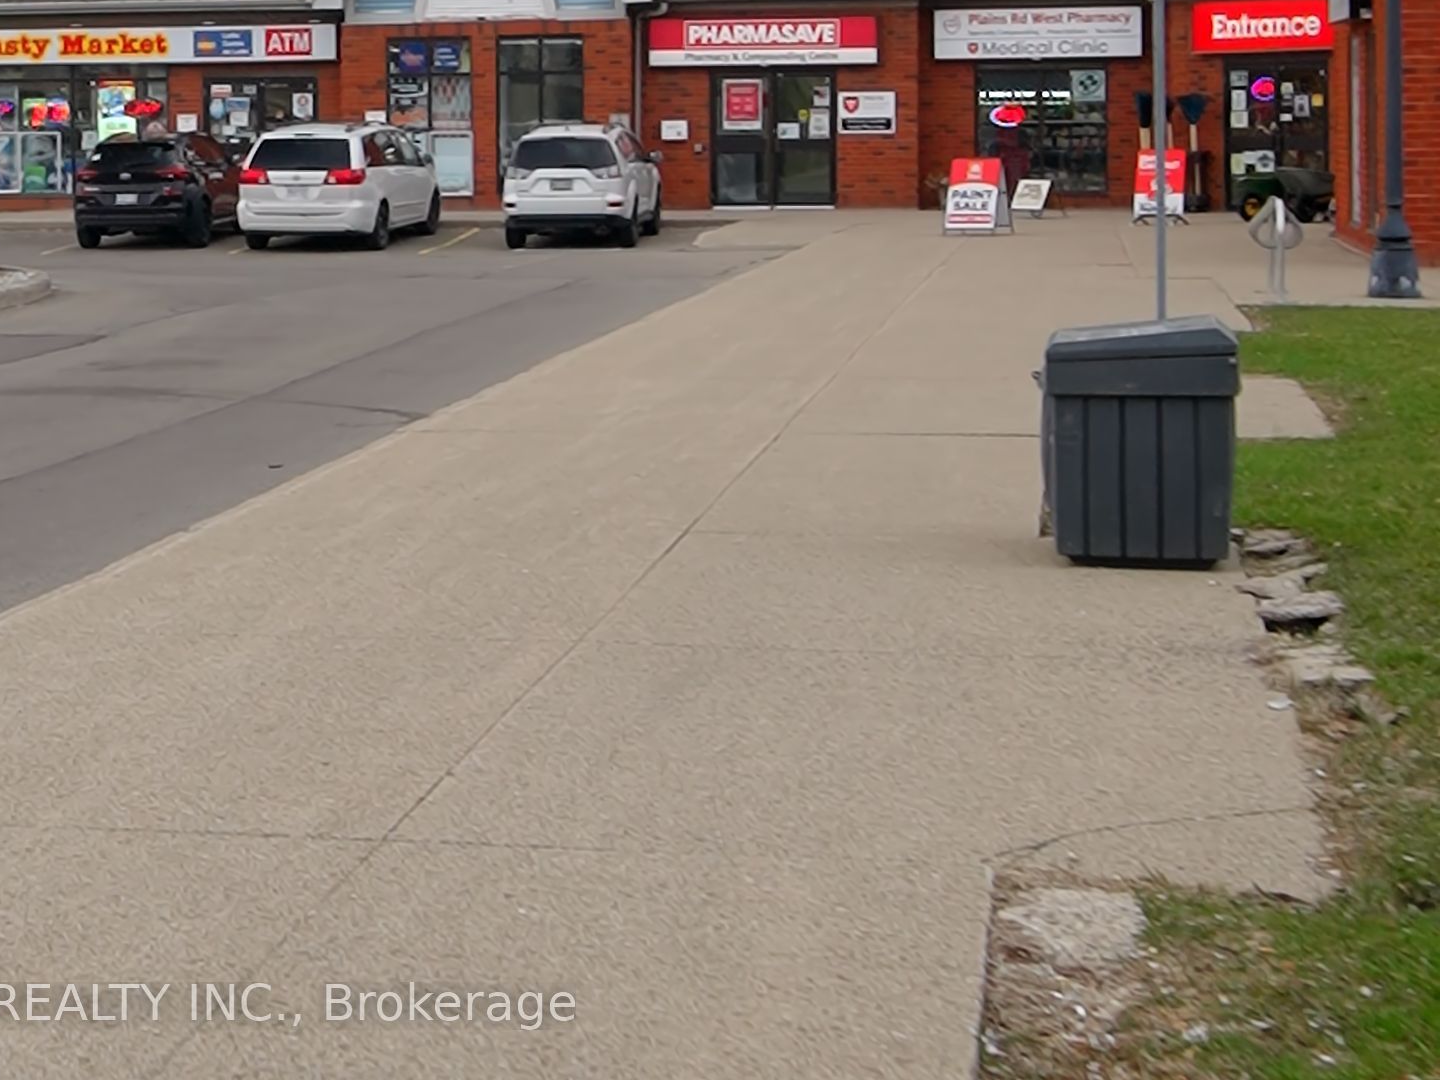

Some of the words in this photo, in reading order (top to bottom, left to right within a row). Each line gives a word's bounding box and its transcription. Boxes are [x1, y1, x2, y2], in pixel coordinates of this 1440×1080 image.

[1029, 12, 1065, 24] West
[1067, 11, 1132, 26] Pharmacy
[1211, 13, 1322, 40] Entrance
[266, 31, 311, 54] ATM
[687, 23, 836, 45] PHARMASAVE
[58, 33, 168, 57] Market
[982, 40, 1053, 56] Medical
[1058, 39, 1109, 55] Clinic
[951, 190, 993, 200] PAINT
[953, 201, 990, 212] SALE
